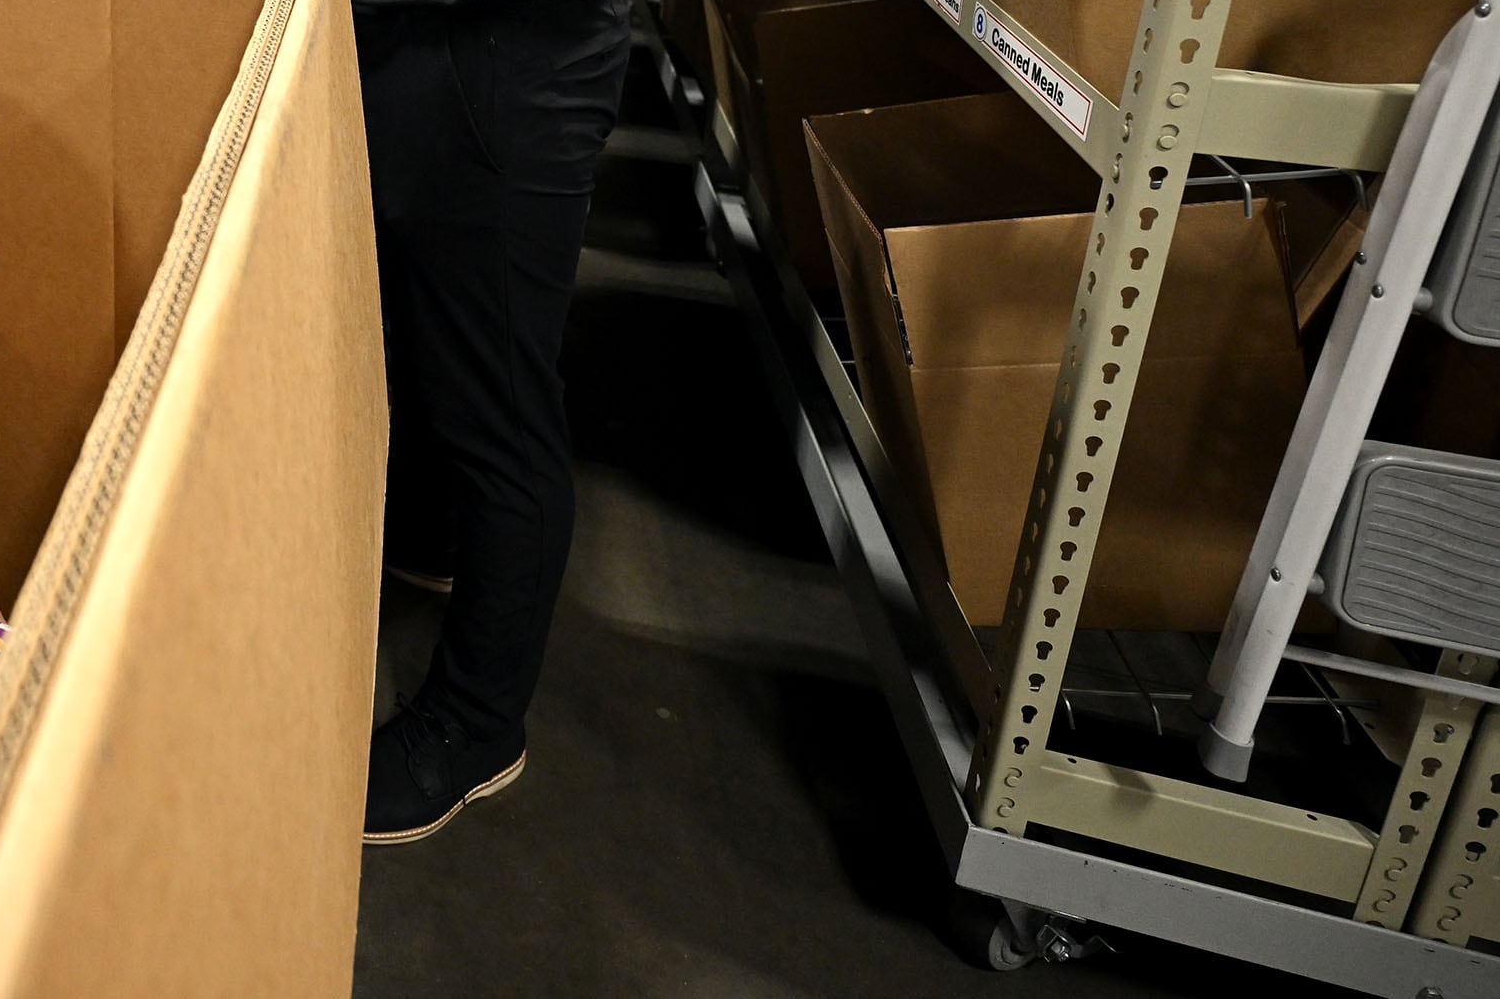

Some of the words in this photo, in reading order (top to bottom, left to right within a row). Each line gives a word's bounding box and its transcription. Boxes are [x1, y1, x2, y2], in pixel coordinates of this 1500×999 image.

[976, 13, 984, 34] 8
[991, 27, 1031, 76] Canned
[1031, 62, 1064, 107] Meals
